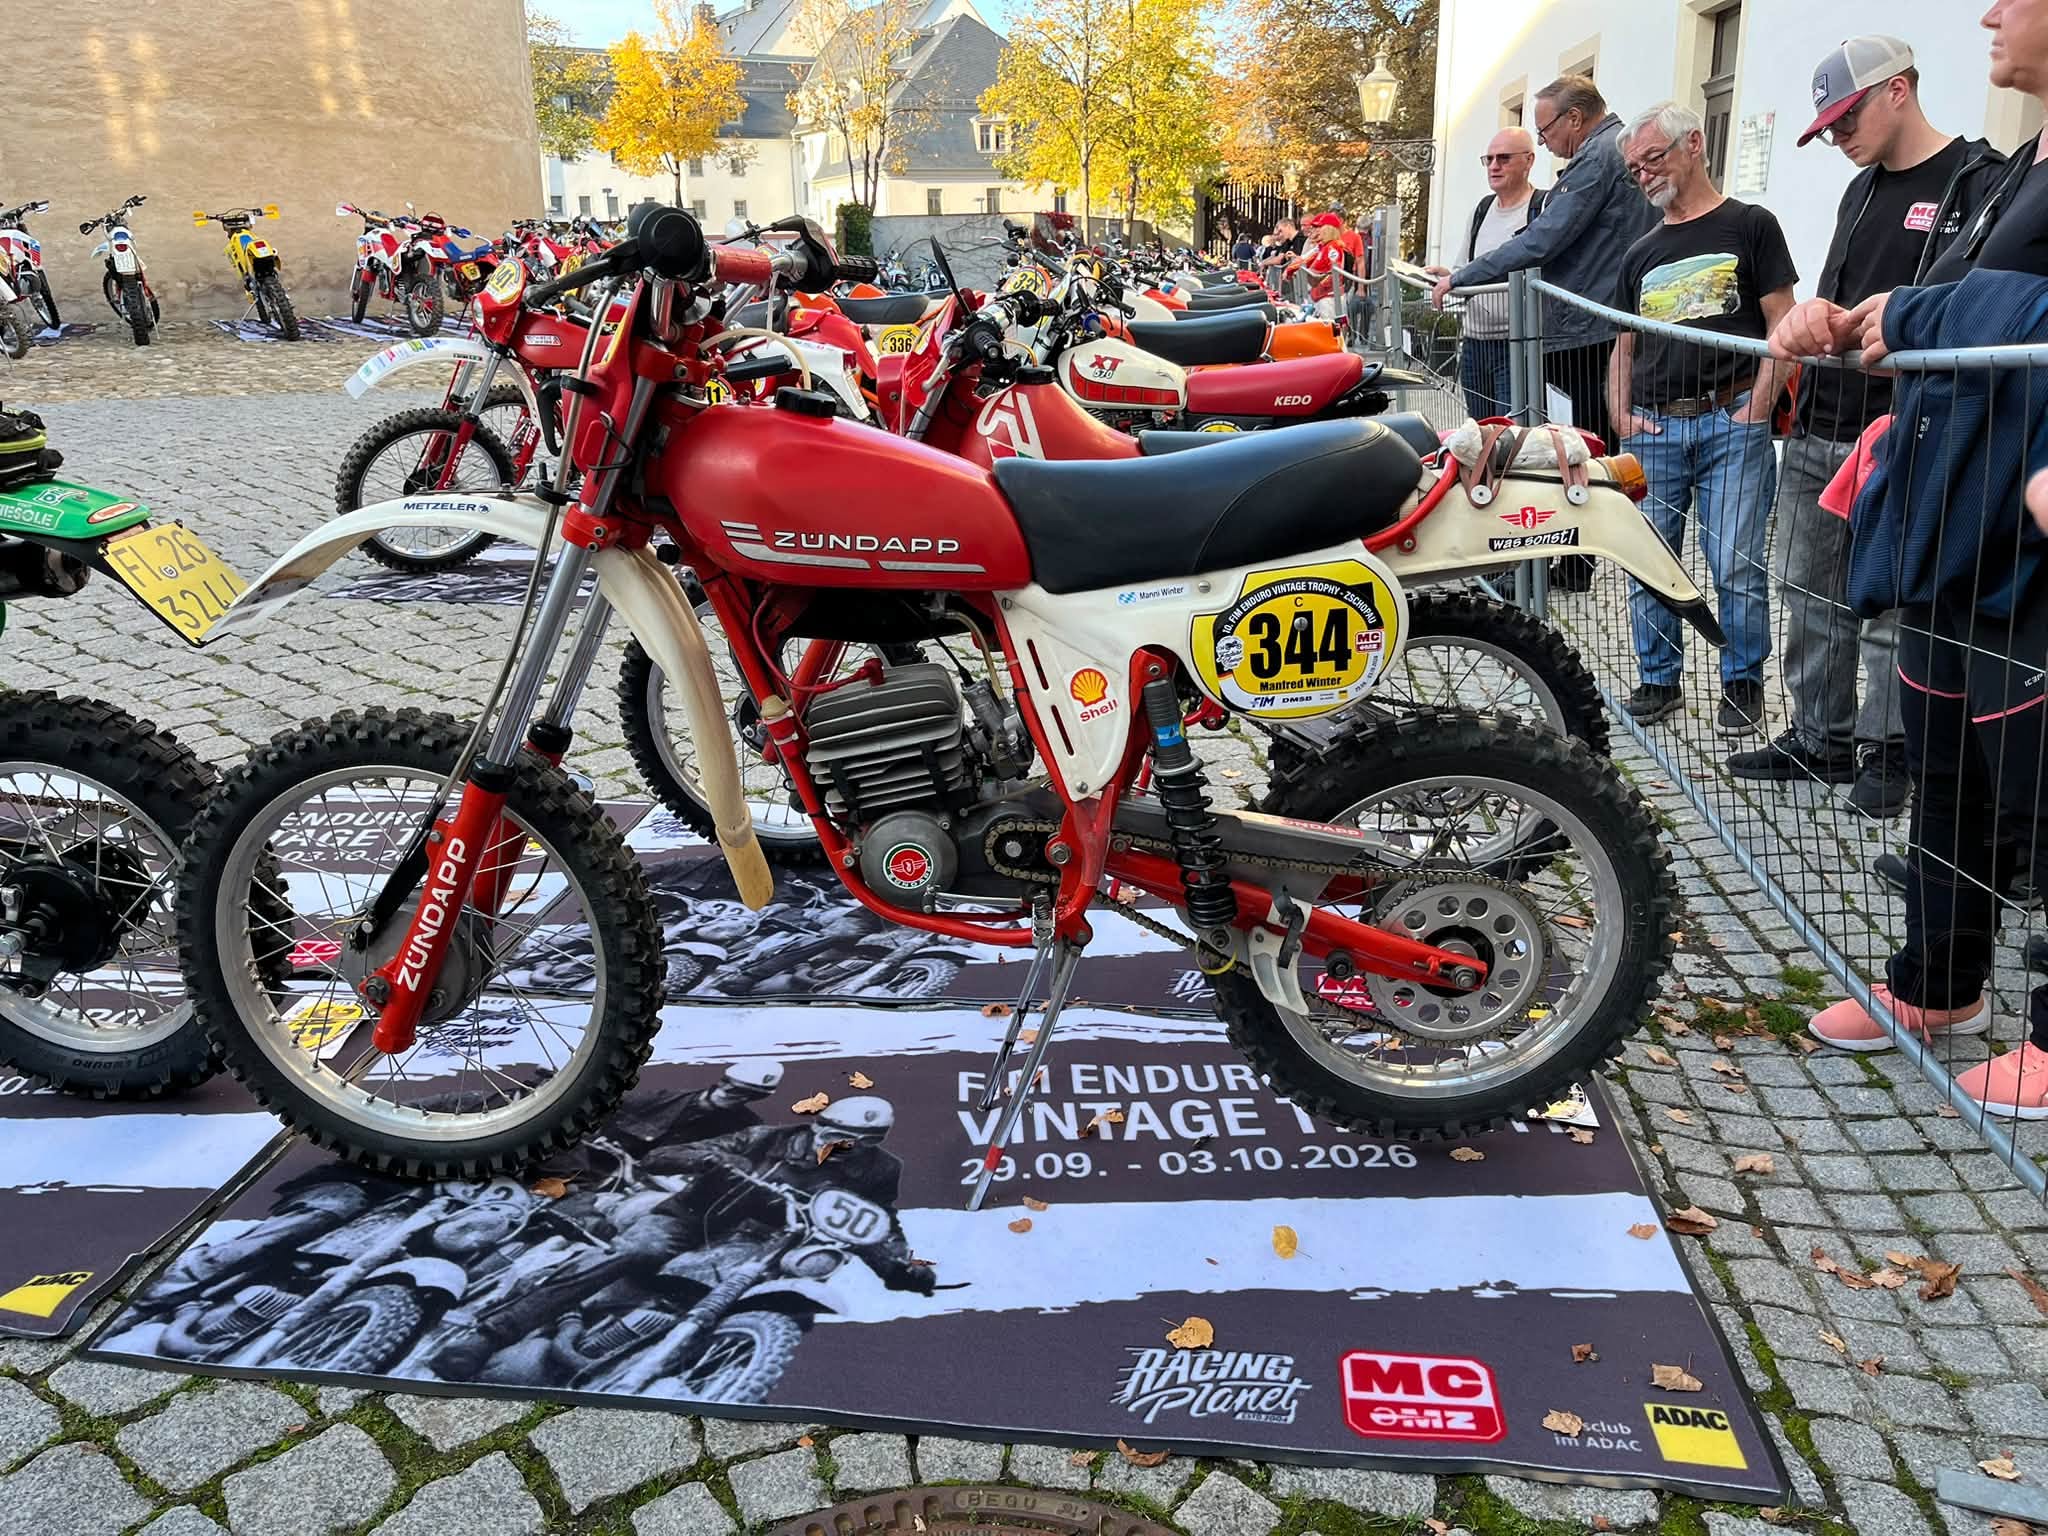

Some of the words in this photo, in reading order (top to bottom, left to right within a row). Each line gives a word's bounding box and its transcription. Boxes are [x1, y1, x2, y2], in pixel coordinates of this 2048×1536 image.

[890, 336, 912, 353] 336
[1089, 354, 1124, 371] XT
[1274, 395, 1312, 407] KEDO
[403, 502, 477, 512] METZELER
[156, 529, 208, 573] 26
[774, 531, 960, 554] ZÜNDAPP
[1493, 538, 1522, 550] was
[1139, 590, 1161, 600] Manni
[1161, 585, 1184, 596] Winter
[1271, 581, 1307, 595] VINTAGE
[1308, 581, 1341, 596] TROPHY
[1240, 588, 1272, 612] ENDURO
[1294, 596, 1304, 608] C
[1343, 590, 1377, 625] ZSCHOPAU
[1228, 608, 1244, 624] FIM
[1222, 623, 1235, 634] 10.
[1249, 607, 1352, 680] 344
[1357, 632, 1380, 643] MC
[1260, 680, 1304, 692] Manfred
[1305, 677, 1342, 688] Winter
[1250, 695, 1275, 708] FIM
[1080, 699, 1118, 723] Shell
[397, 837, 468, 993] ZÜNDAPP
[1071, 1063, 1271, 1096] ENDUR
[1159, 1143, 1418, 1176] 03.10.2026
[825, 1194, 880, 1240] 50
[23, 1273, 89, 1287] ADAC
[1113, 1346, 1294, 1400] RACING
[1350, 1358, 1484, 1398] MC
[1130, 1376, 1312, 1425] Planet
[1653, 1405, 1729, 1431] ADAC
[1555, 1434, 1579, 1447] im
[1586, 1435, 1643, 1452] ADAC
